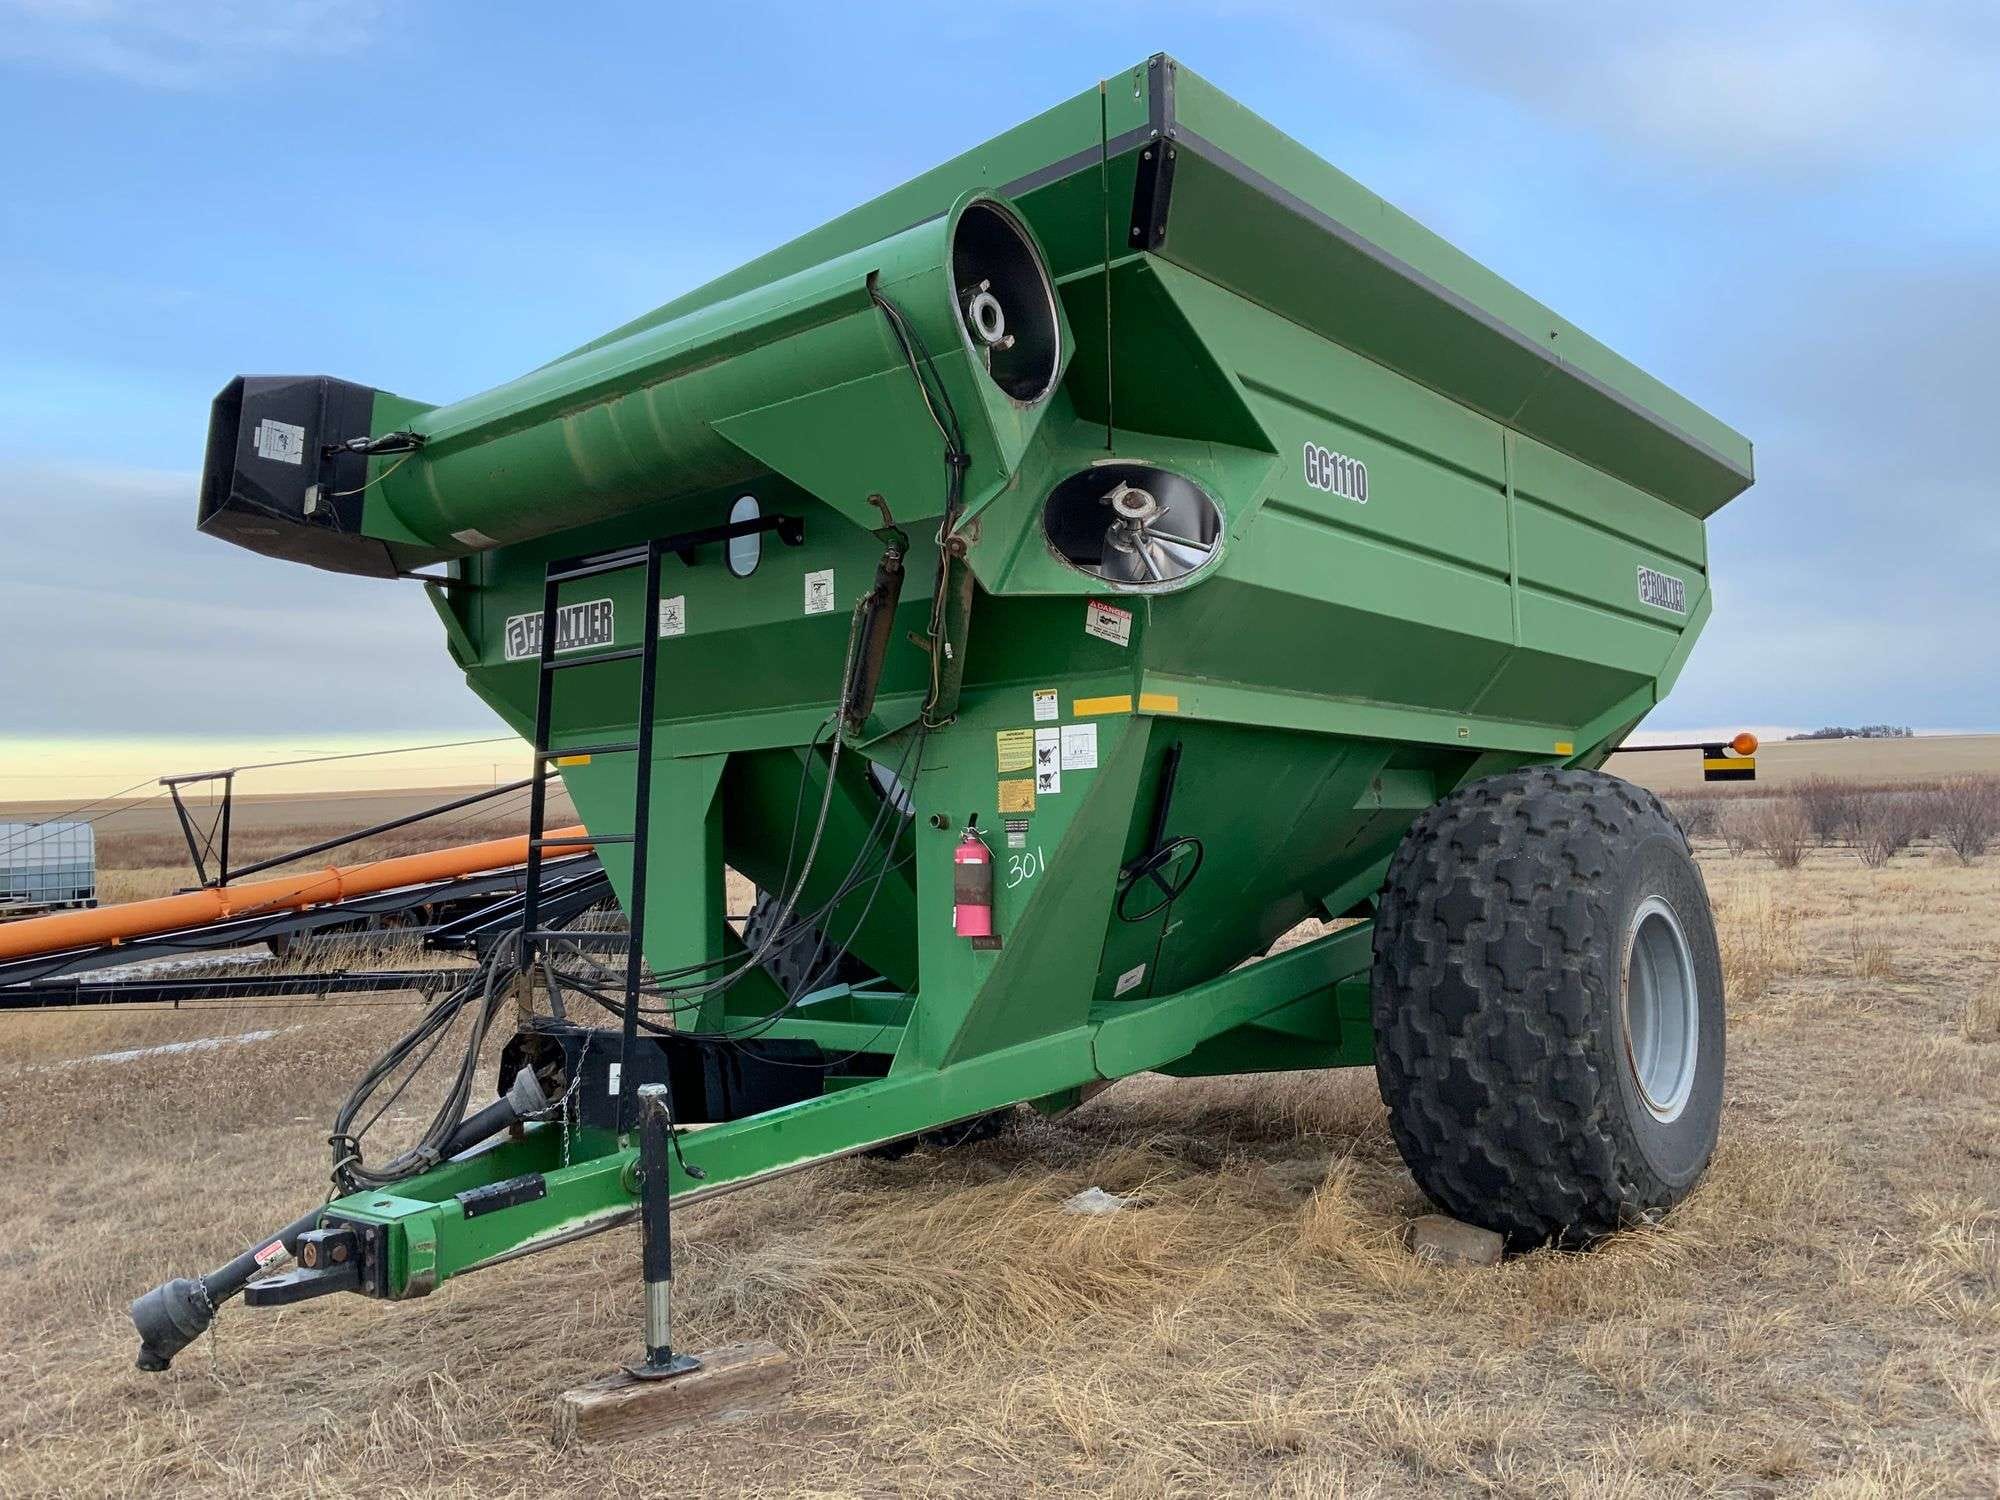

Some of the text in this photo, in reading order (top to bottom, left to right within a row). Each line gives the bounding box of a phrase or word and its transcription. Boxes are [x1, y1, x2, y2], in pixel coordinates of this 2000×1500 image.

[1305, 444, 1367, 502] GC1110
[1646, 569, 1685, 606] FRONTIER
[524, 600, 613, 647] FRNTIER
[1006, 846, 1045, 889] 301
